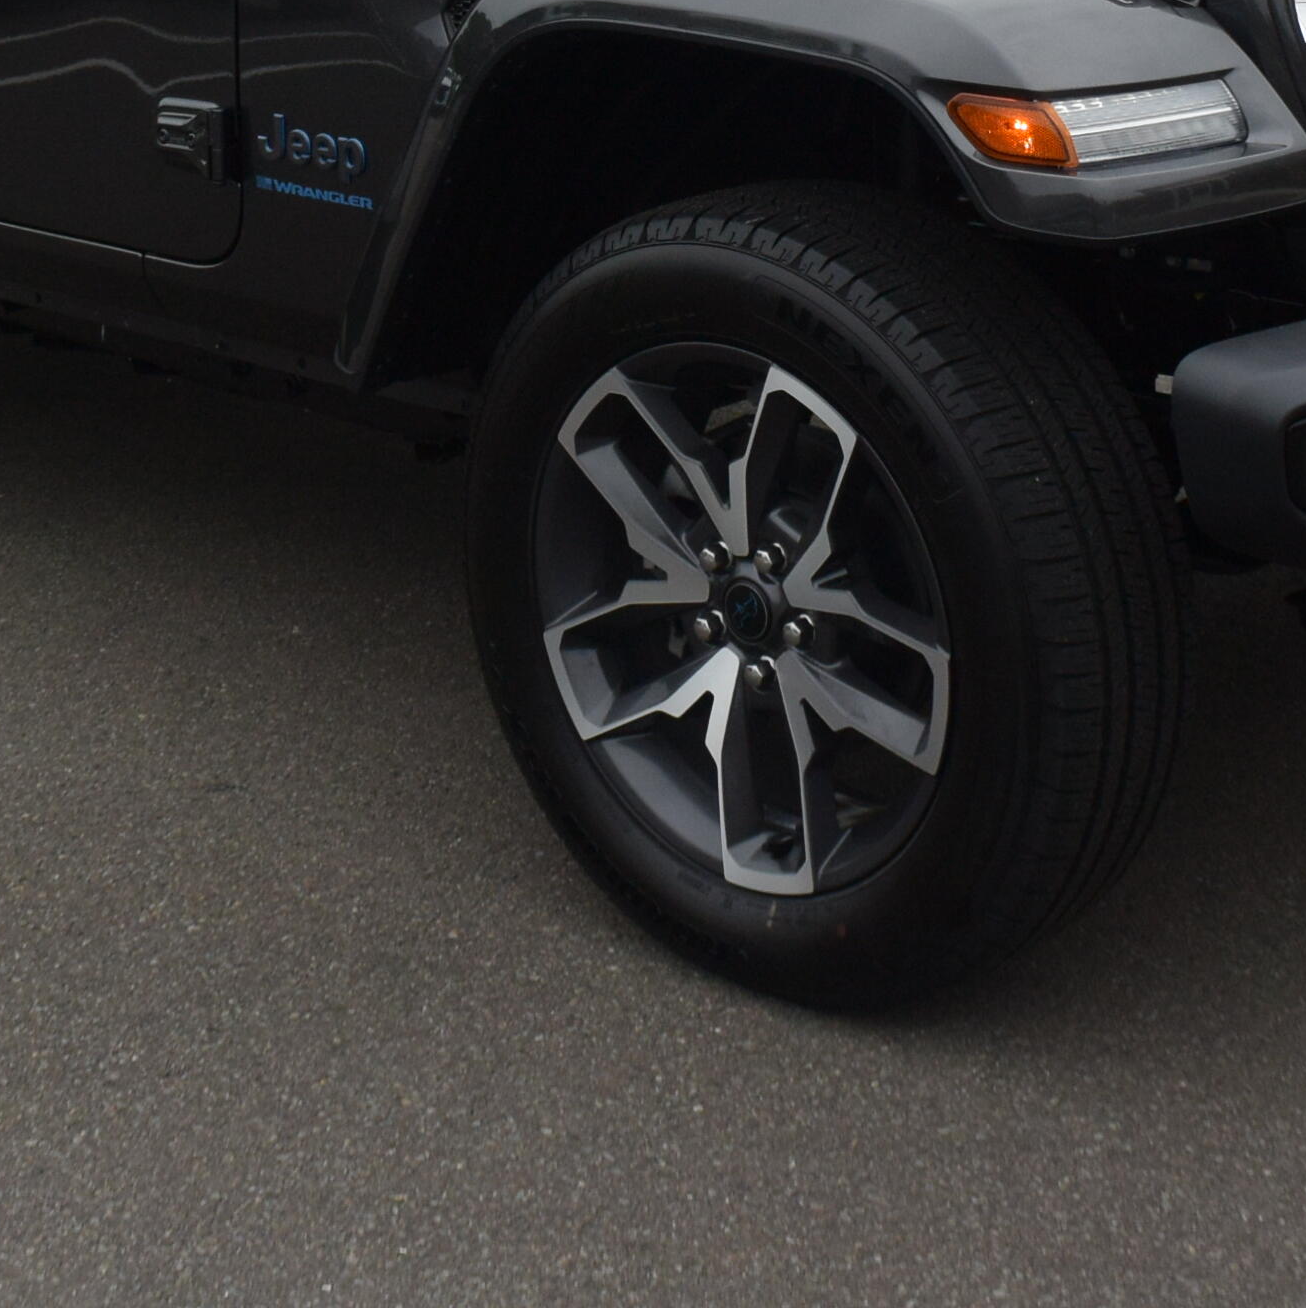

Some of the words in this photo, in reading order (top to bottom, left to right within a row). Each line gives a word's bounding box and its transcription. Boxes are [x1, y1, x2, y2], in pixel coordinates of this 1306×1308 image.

[256, 112, 367, 185] Jeep
[272, 179, 374, 211] WRANGLER
[775, 294, 938, 464] NEXEN
